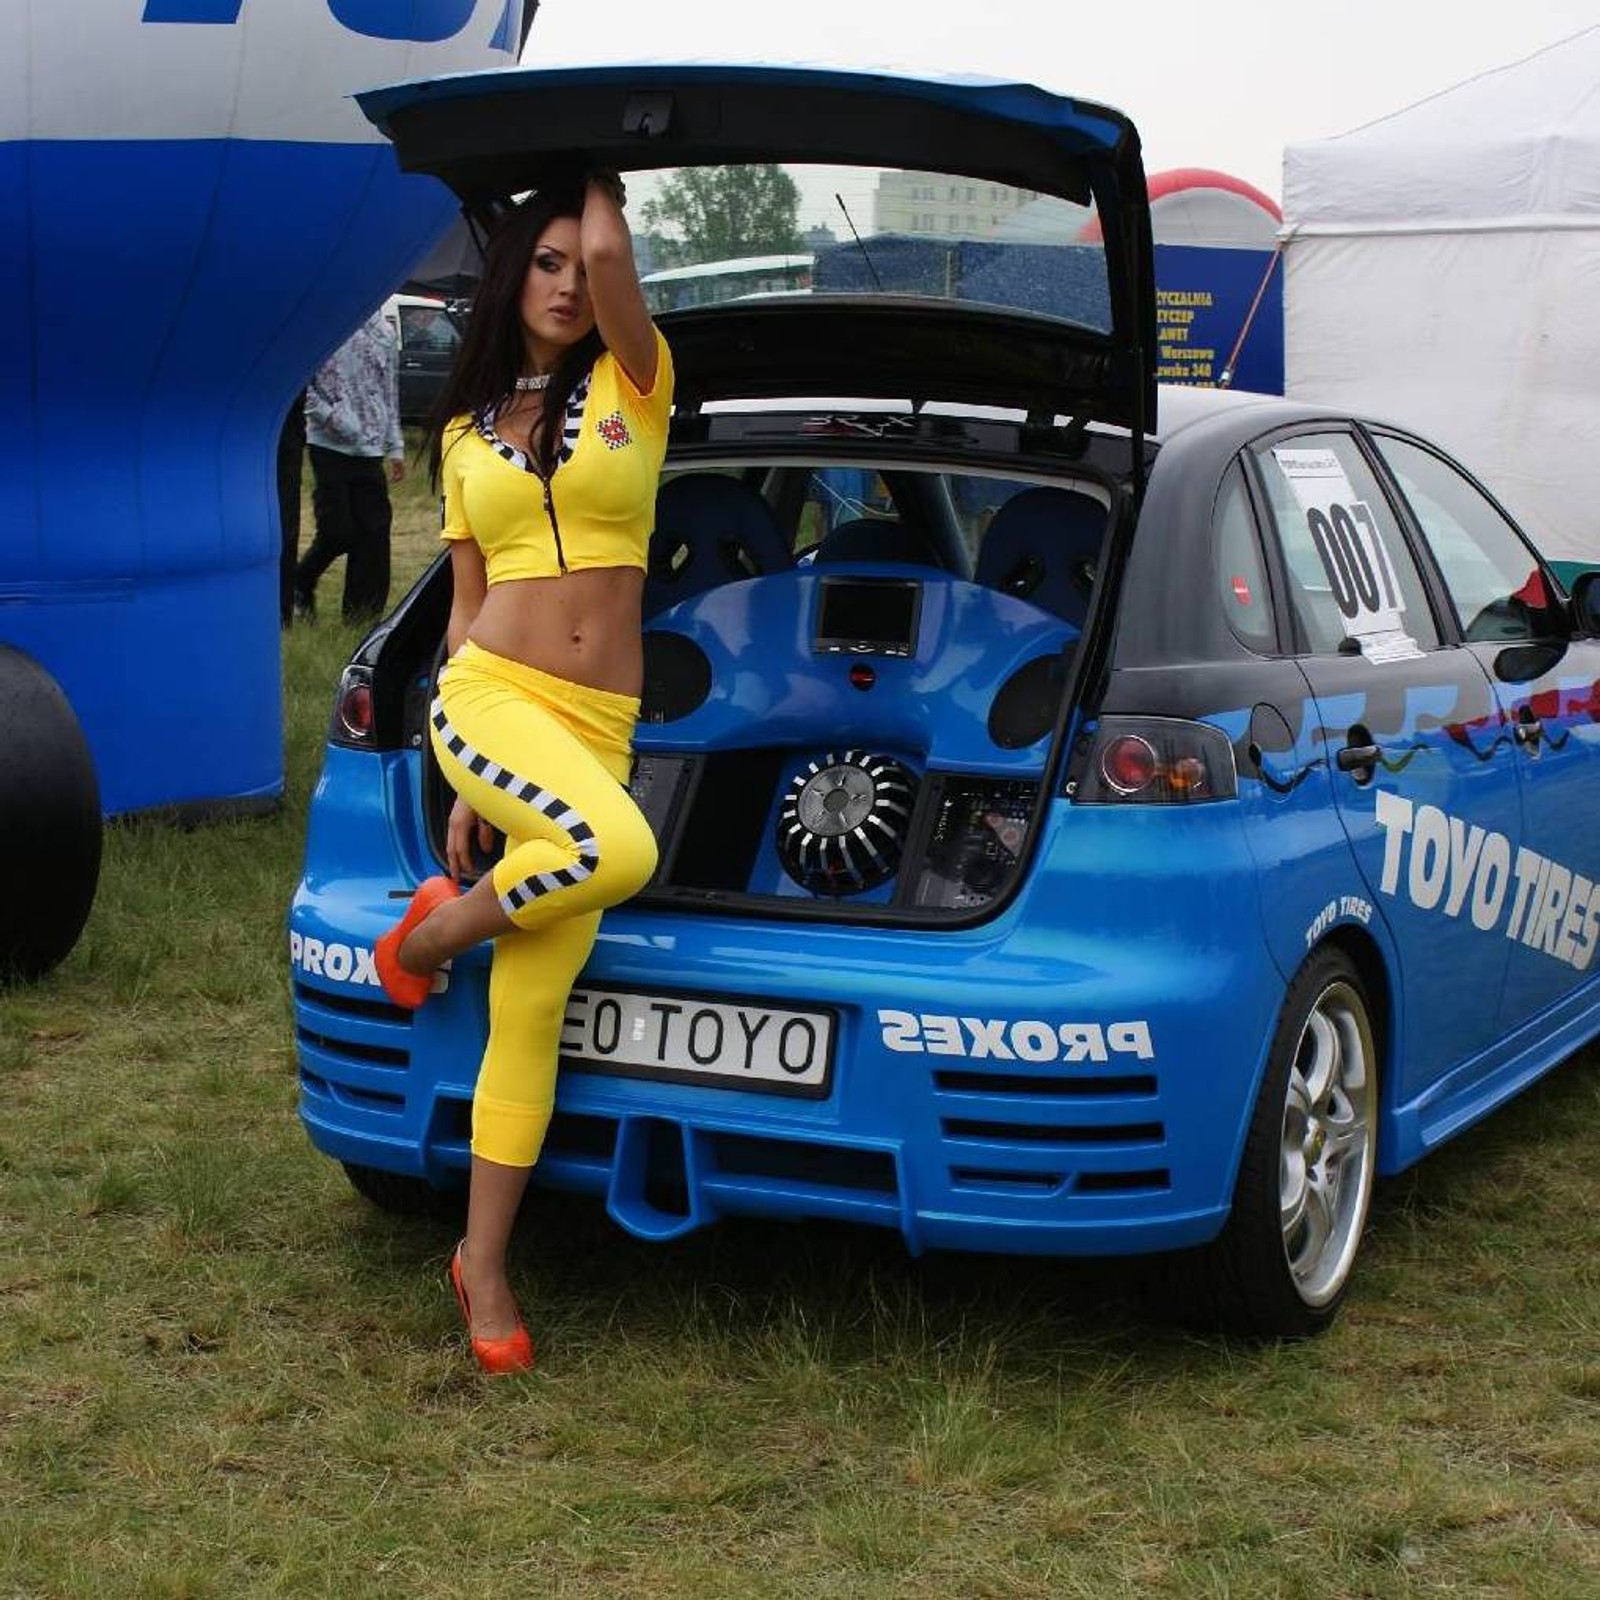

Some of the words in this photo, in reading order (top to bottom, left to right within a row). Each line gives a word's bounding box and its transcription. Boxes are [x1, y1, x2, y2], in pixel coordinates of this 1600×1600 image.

[1306, 503, 1397, 619] 007
[1376, 789, 1510, 931] TOYO
[1506, 846, 1600, 971] TIRES
[1305, 901, 1336, 947] TOYO
[1340, 896, 1372, 924] TIRES
[290, 930, 452, 994] PROX
[650, 1002, 816, 1074] TOYO
